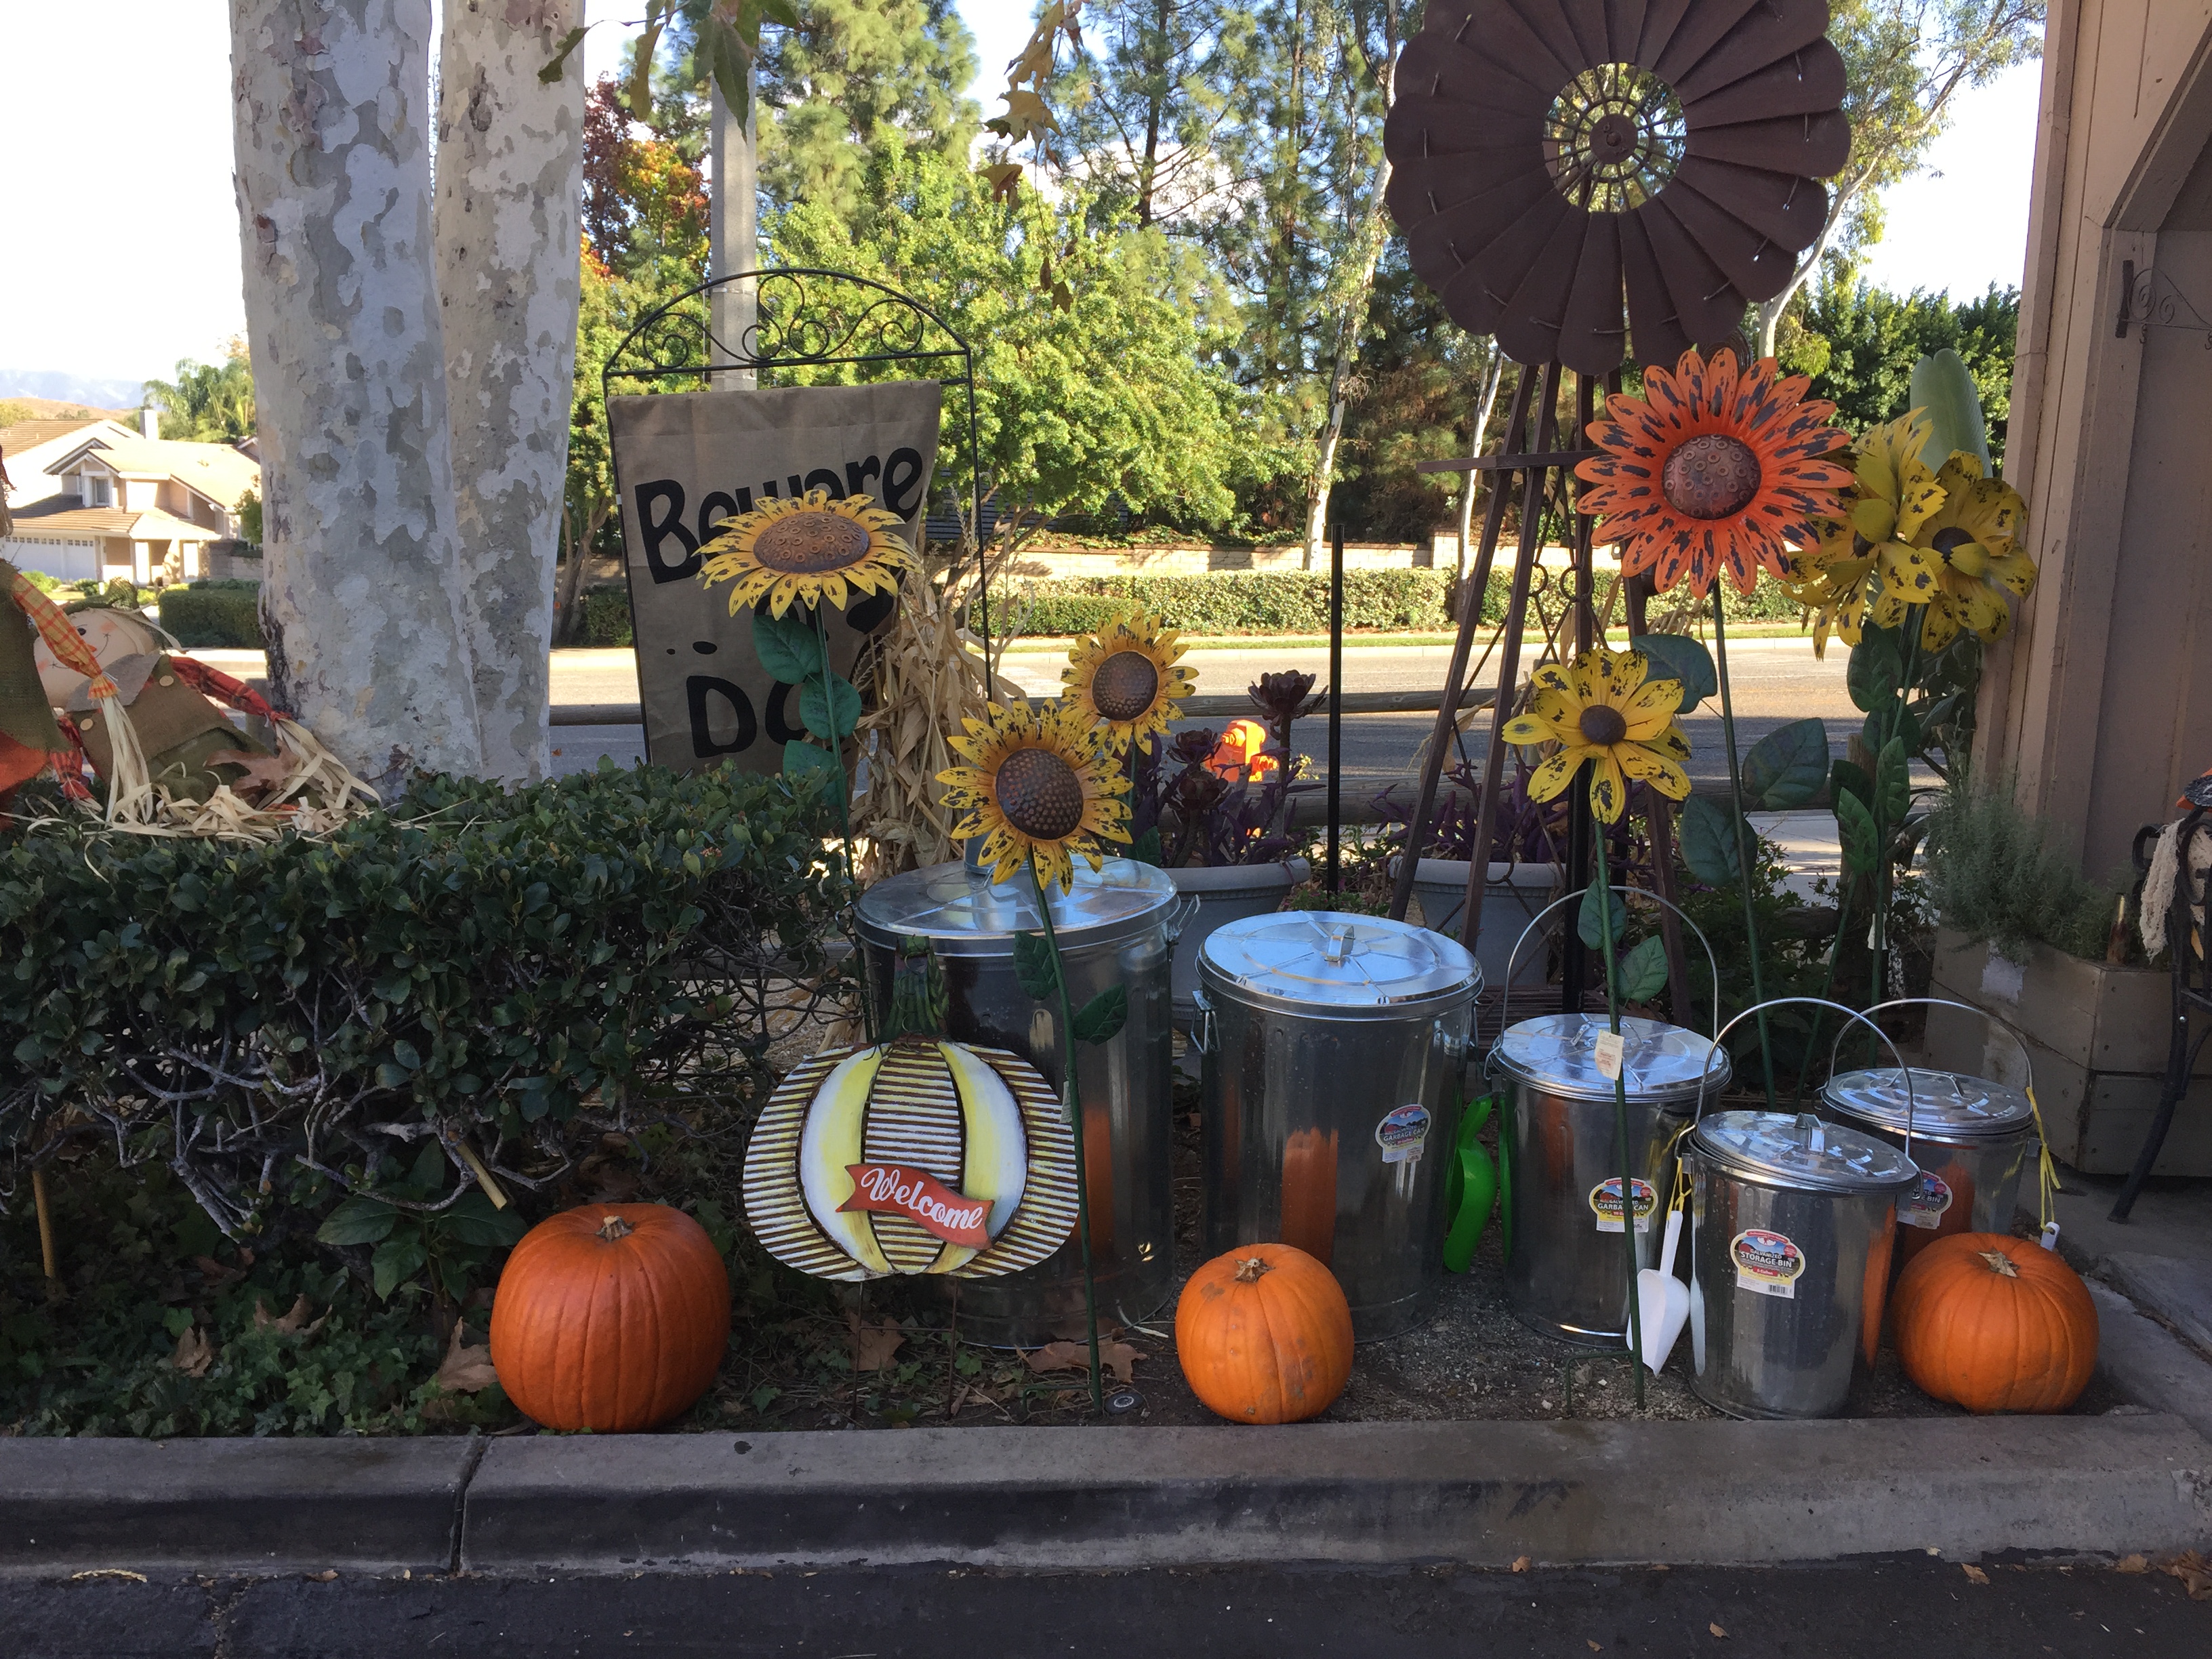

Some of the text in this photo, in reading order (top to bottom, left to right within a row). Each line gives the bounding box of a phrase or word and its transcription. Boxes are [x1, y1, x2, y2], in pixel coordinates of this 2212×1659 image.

[1383, 1130, 1411, 1141] GARBAGE
[861, 1168, 983, 1229] Welcome
[1740, 1251, 1776, 1265] STORAGE
[1778, 1259, 1792, 1268] BIN
[1750, 1248, 1782, 1259] GALVANIZED
